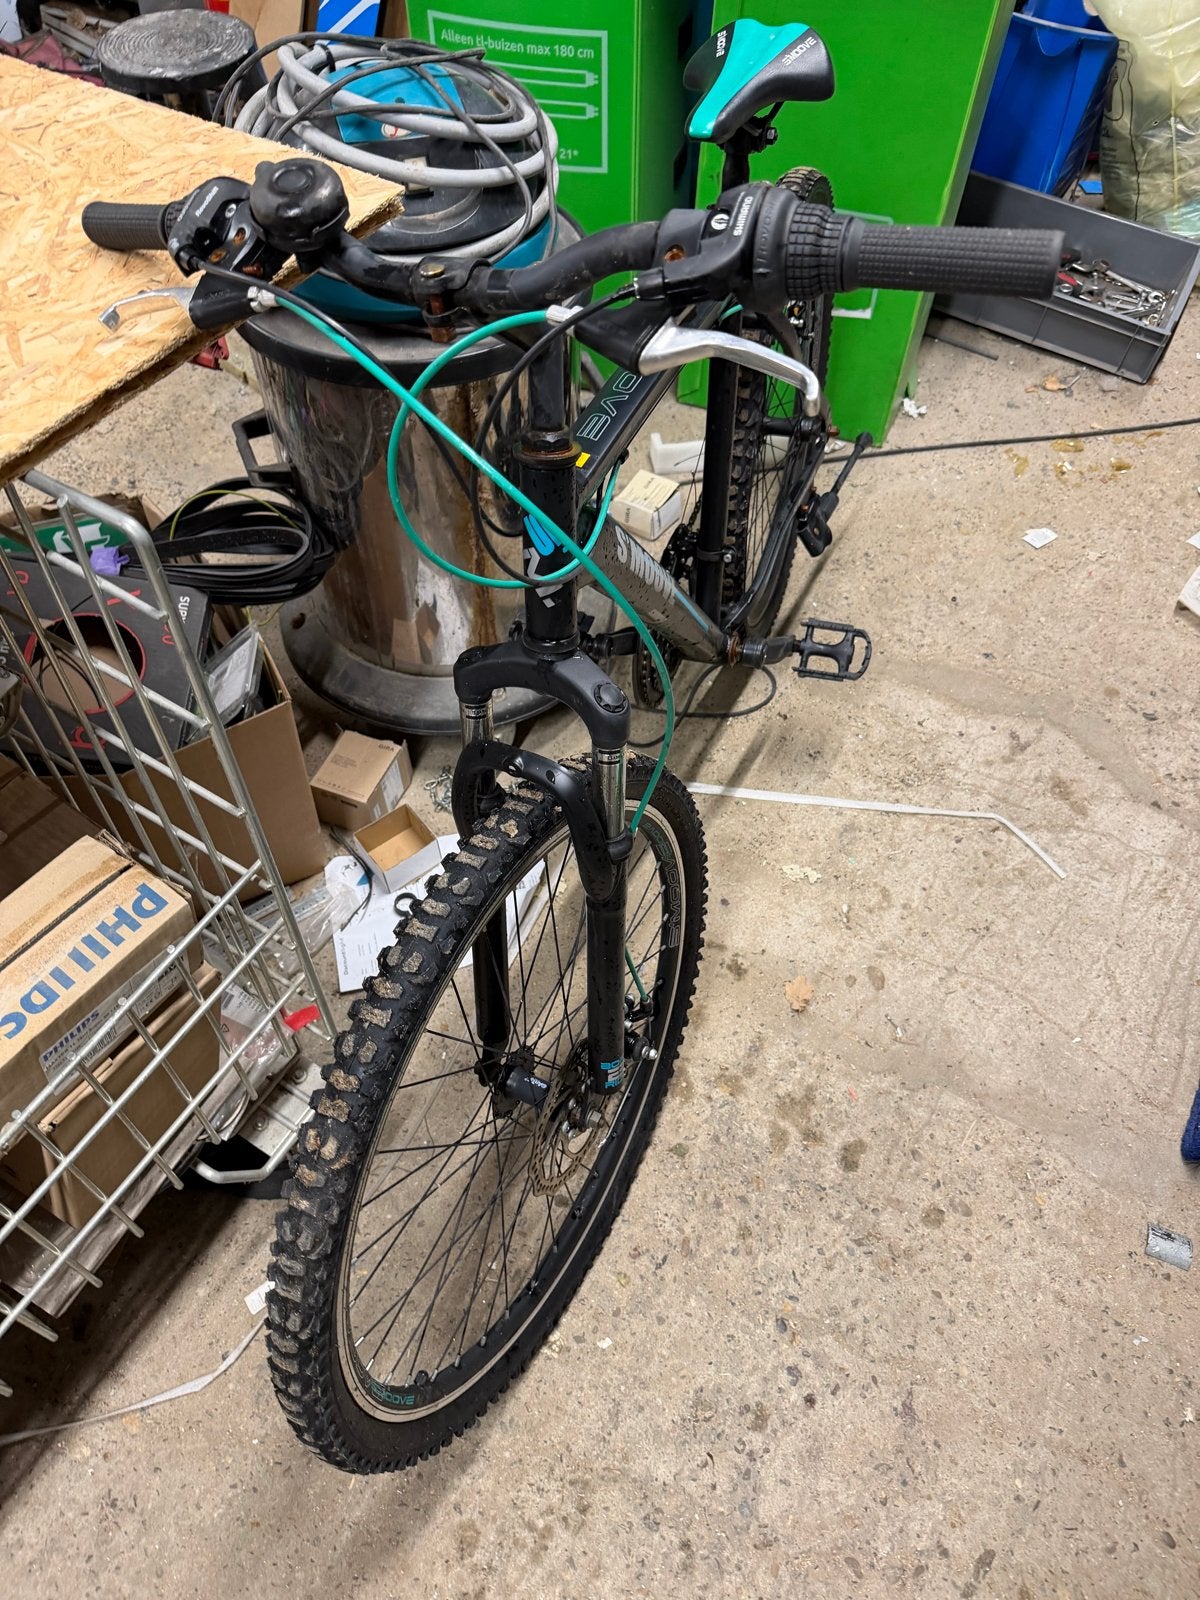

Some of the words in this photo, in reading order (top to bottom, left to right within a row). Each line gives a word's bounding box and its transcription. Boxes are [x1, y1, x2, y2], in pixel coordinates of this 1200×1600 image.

[441, 28, 474, 47] Alleen
[476, 35, 525, 54] tl-buizen
[526, 43, 551, 56] max
[553, 44, 575, 58] 180
[577, 47, 595, 59] cm
[733, 195, 754, 237] SHIMANO
[42, 1009, 100, 1064] PHILIPS
